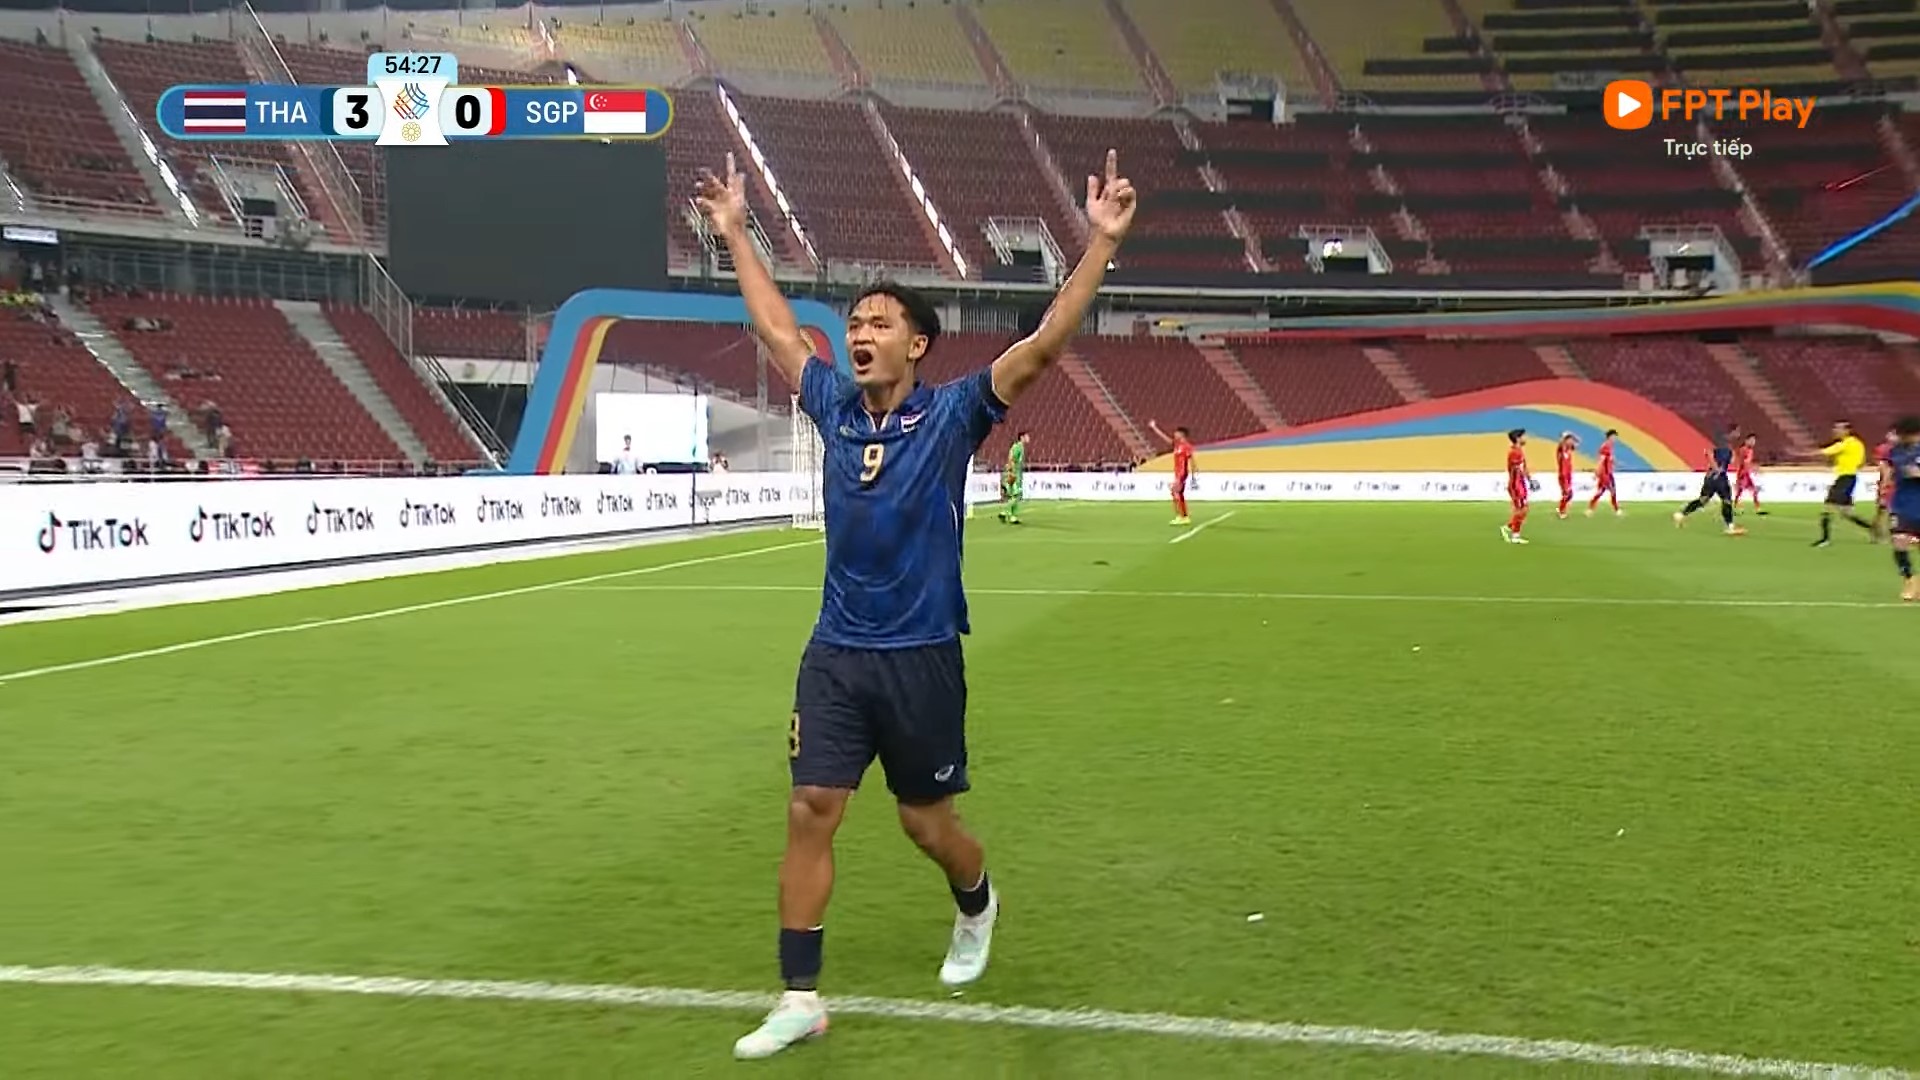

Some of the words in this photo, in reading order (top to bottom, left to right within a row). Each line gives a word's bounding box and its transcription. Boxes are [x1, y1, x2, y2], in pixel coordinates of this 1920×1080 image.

[860, 443, 885, 482] 9
[323, 506, 375, 533] TikTok
[413, 503, 456, 526] TikTok
[489, 499, 524, 522] TikTok
[550, 496, 581, 517] TikTok
[67, 517, 149, 550] TikTok
[212, 511, 276, 541] TikTok
